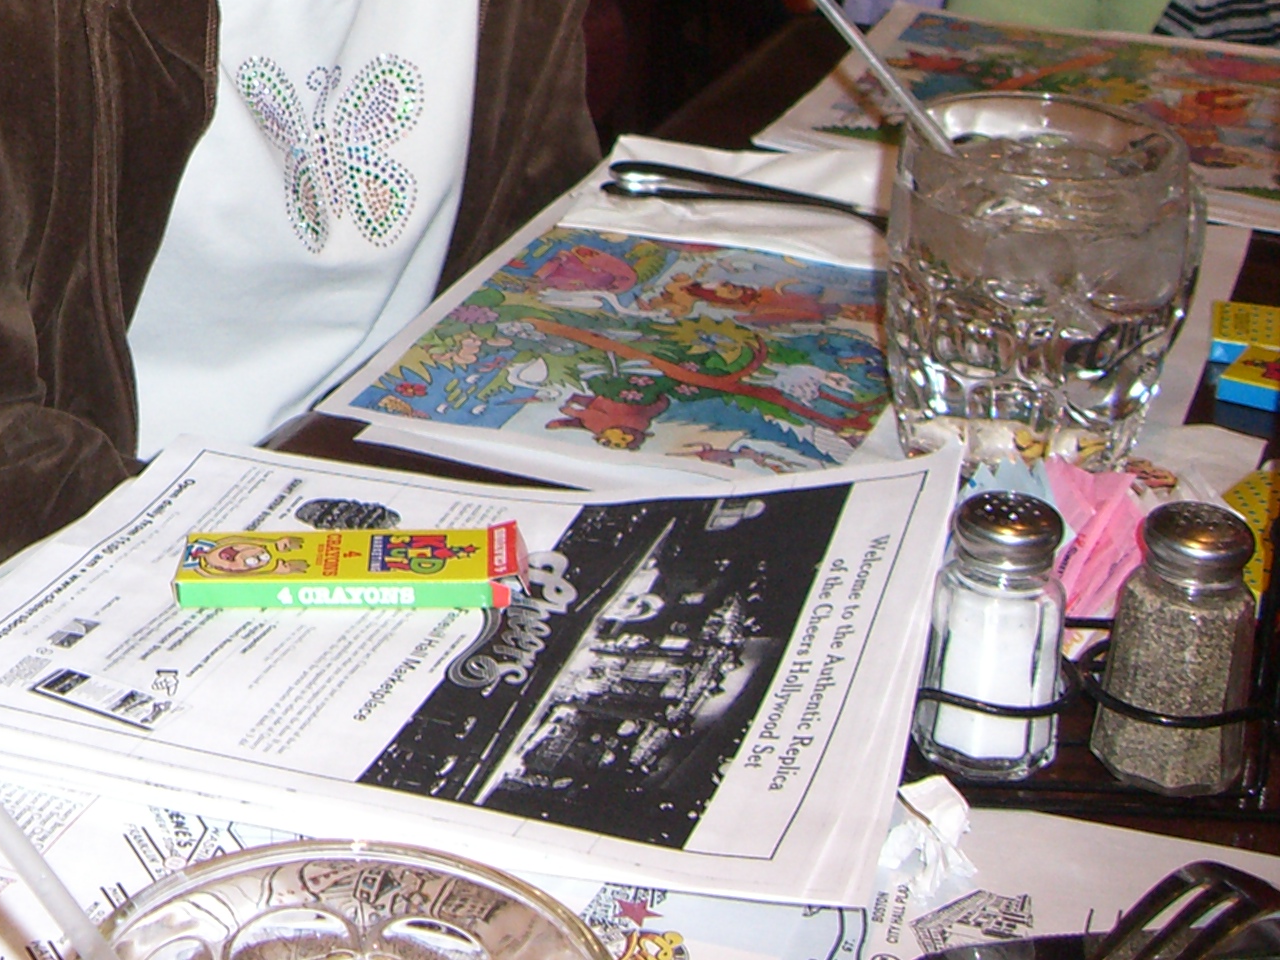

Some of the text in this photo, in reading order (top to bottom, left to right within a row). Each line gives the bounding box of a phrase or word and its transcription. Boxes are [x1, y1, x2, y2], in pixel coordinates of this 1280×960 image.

[171, 478, 196, 499] Open
[128, 518, 153, 536] from
[323, 534, 342, 576] CRAYONS
[277, 586, 415, 605] 4 CRAYONS
[456, 550, 577, 685] Cheers
[415, 637, 440, 659] Hall
[744, 558, 849, 769] of the Cheers Hollywood Set
[768, 534, 891, 792] Welcome to the Authentic Replica
[353, 656, 421, 722] Marketplace
[871, 891, 889, 923] BOSTON
[890, 906, 904, 925] HALL
[886, 925, 901, 944] CITY
